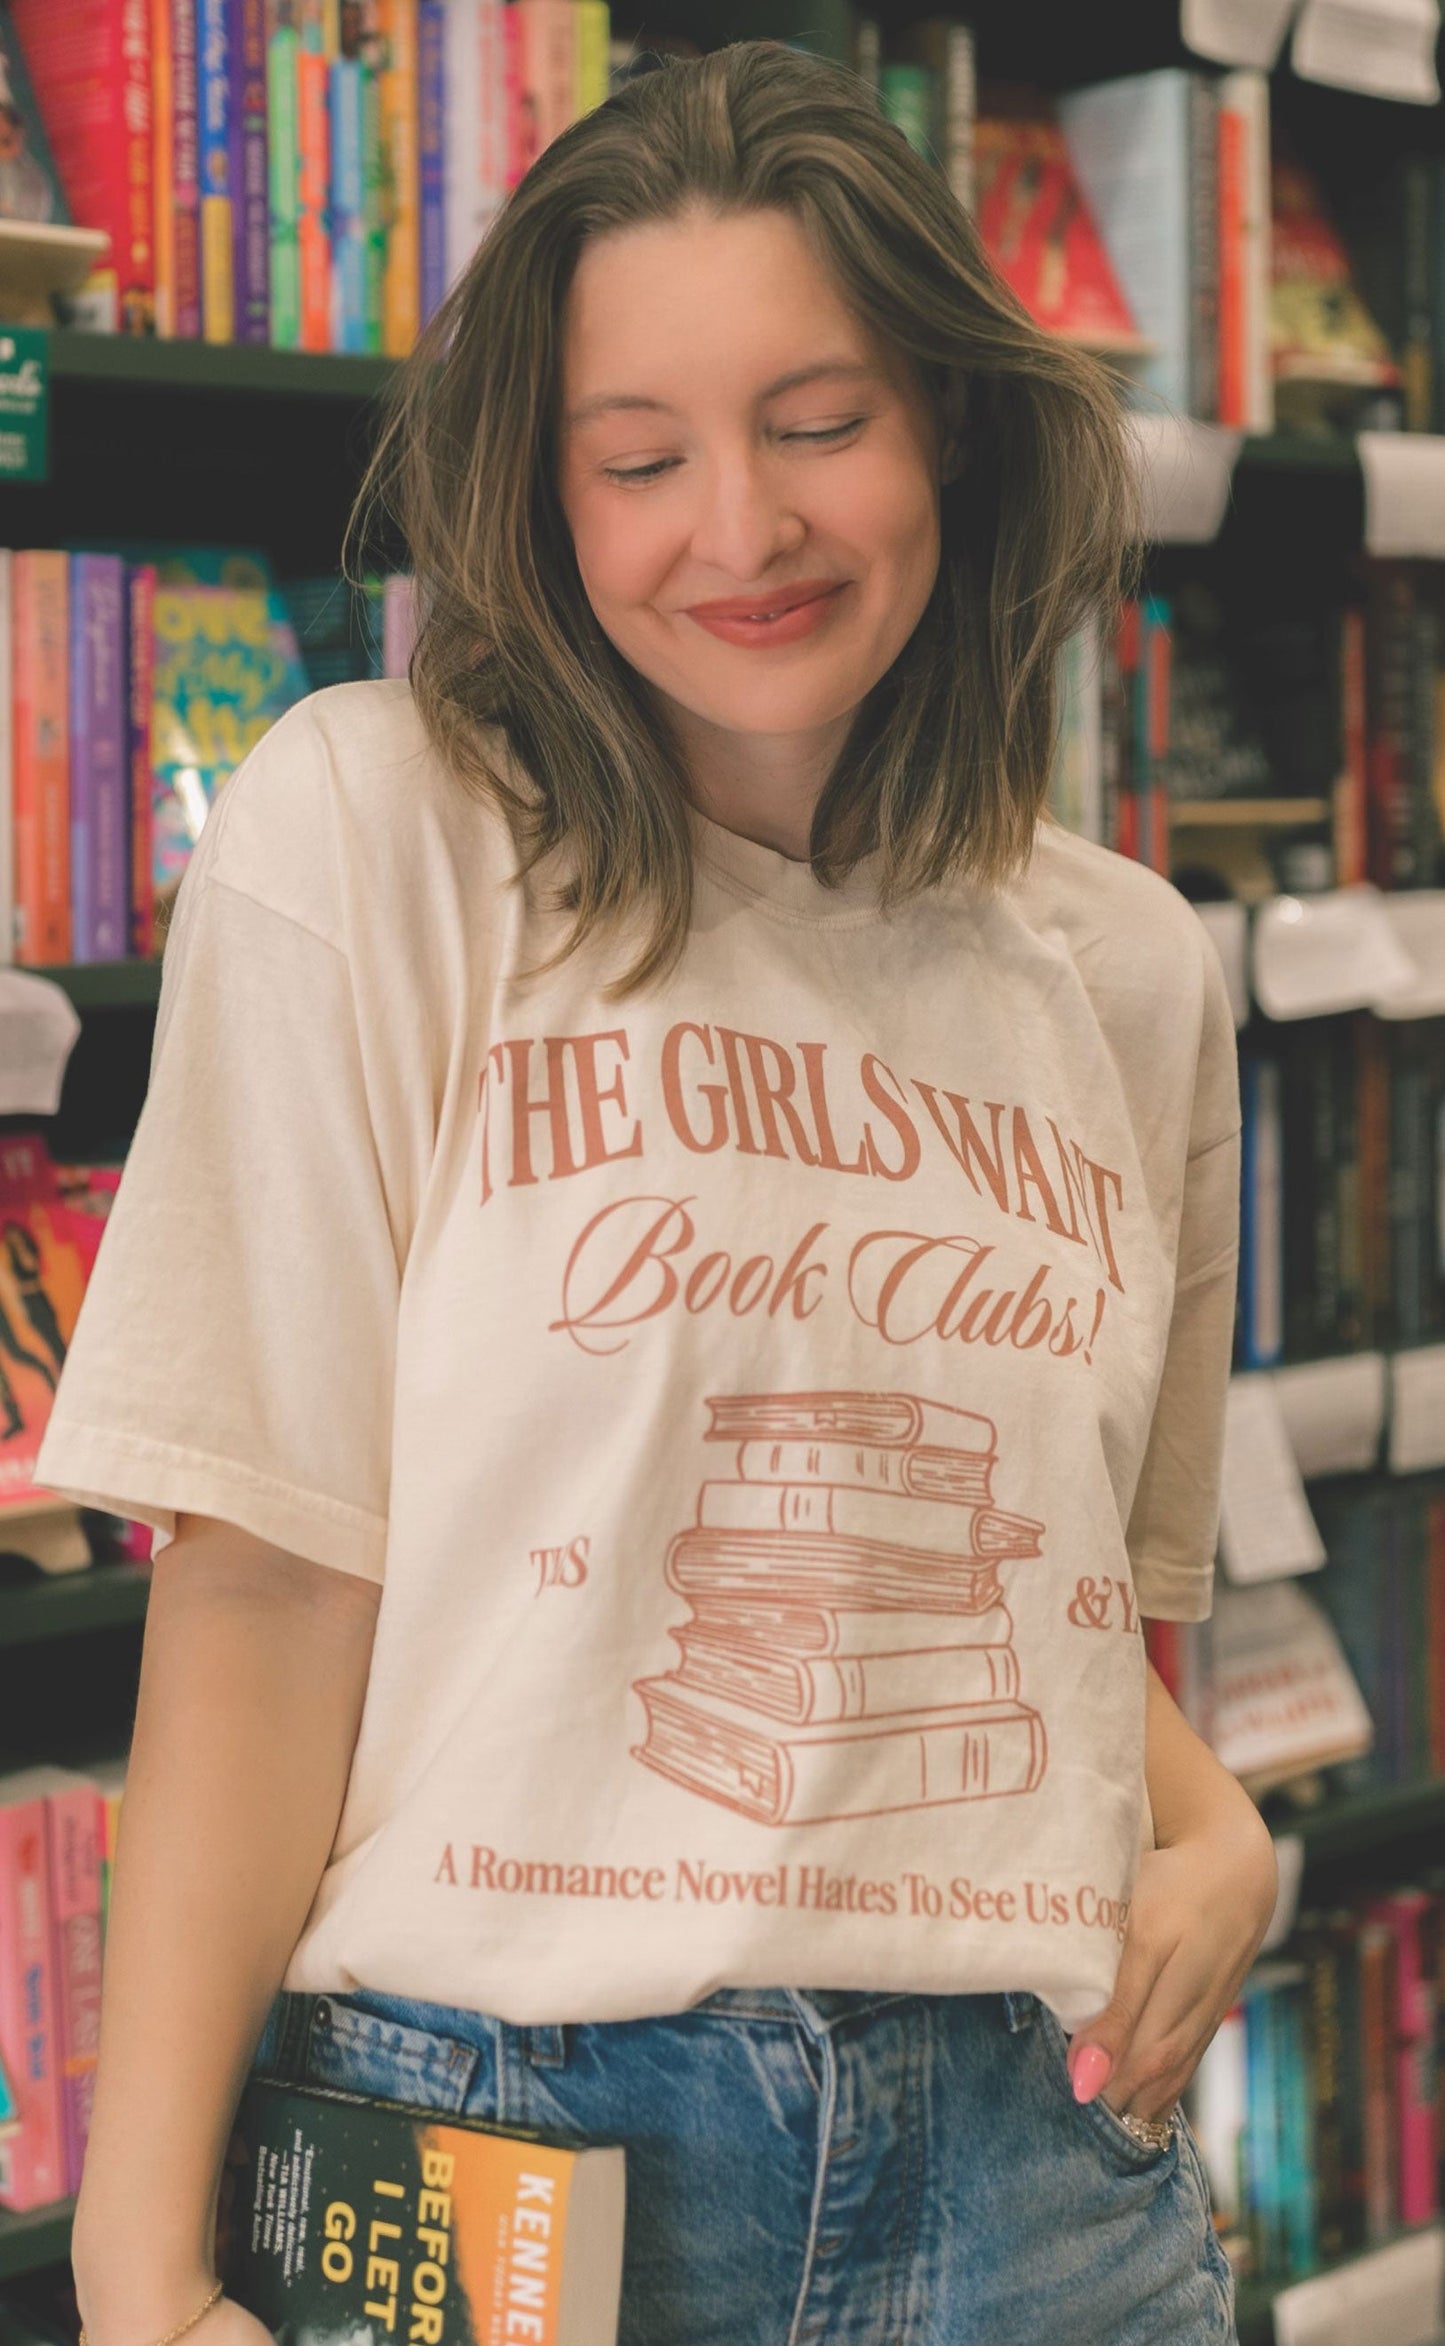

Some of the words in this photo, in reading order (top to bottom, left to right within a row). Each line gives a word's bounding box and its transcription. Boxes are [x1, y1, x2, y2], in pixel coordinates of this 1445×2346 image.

[478, 1029, 643, 1208] THE
[660, 1021, 921, 1182] GIRLS
[910, 1078, 1125, 1294] WANT
[548, 1195, 830, 1356] Book
[847, 1229, 1106, 1366] Clubs!
[434, 1842, 459, 1887] A
[469, 1844, 667, 1901] Romance
[676, 1859, 789, 1908] Novel
[796, 1865, 897, 1916] Hates
[903, 1873, 943, 1918] To
[950, 1877, 1016, 1922] See
[1024, 1882, 1070, 1925] Us
[294, 2128, 302, 2152] and
[263, 2213, 274, 2250] Times
[373, 2180, 405, 2199] I
[321, 2201, 356, 2284] GO
[364, 2220, 402, 2333] LET
[408, 2150, 454, 2346] BEFOR
[504, 2172, 555, 2346] KENNE
